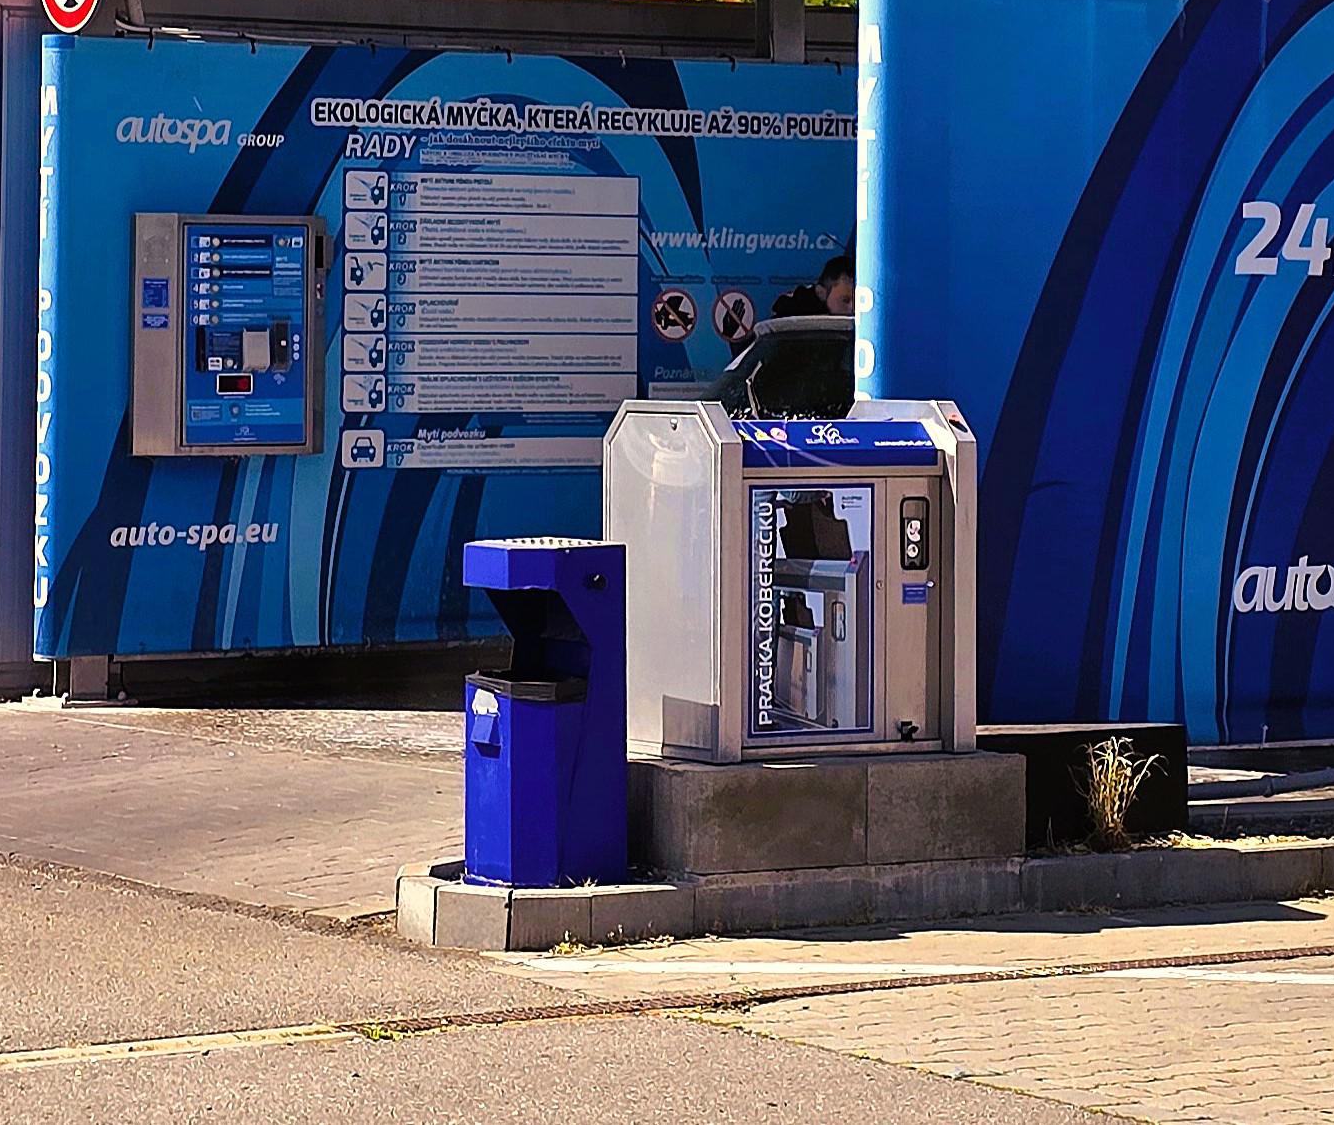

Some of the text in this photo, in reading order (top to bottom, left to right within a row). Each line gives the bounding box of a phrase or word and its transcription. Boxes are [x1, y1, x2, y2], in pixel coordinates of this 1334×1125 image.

[117, 113, 284, 153] autospa GROUP
[314, 97, 440, 126] EKOLOGICKÁ
[446, 99, 523, 131] MYČKA,
[528, 105, 591, 130] KTERÁ
[598, 109, 703, 135] RECYKLUJE
[708, 107, 733, 136] AŽ
[738, 115, 783, 137] 90%
[345, 134, 417, 159] RADY
[651, 227, 836, 253] www.klingwash.cz
[110, 522, 278, 551] auto-spa.eu
[755, 638, 773, 725] PRAČKA
